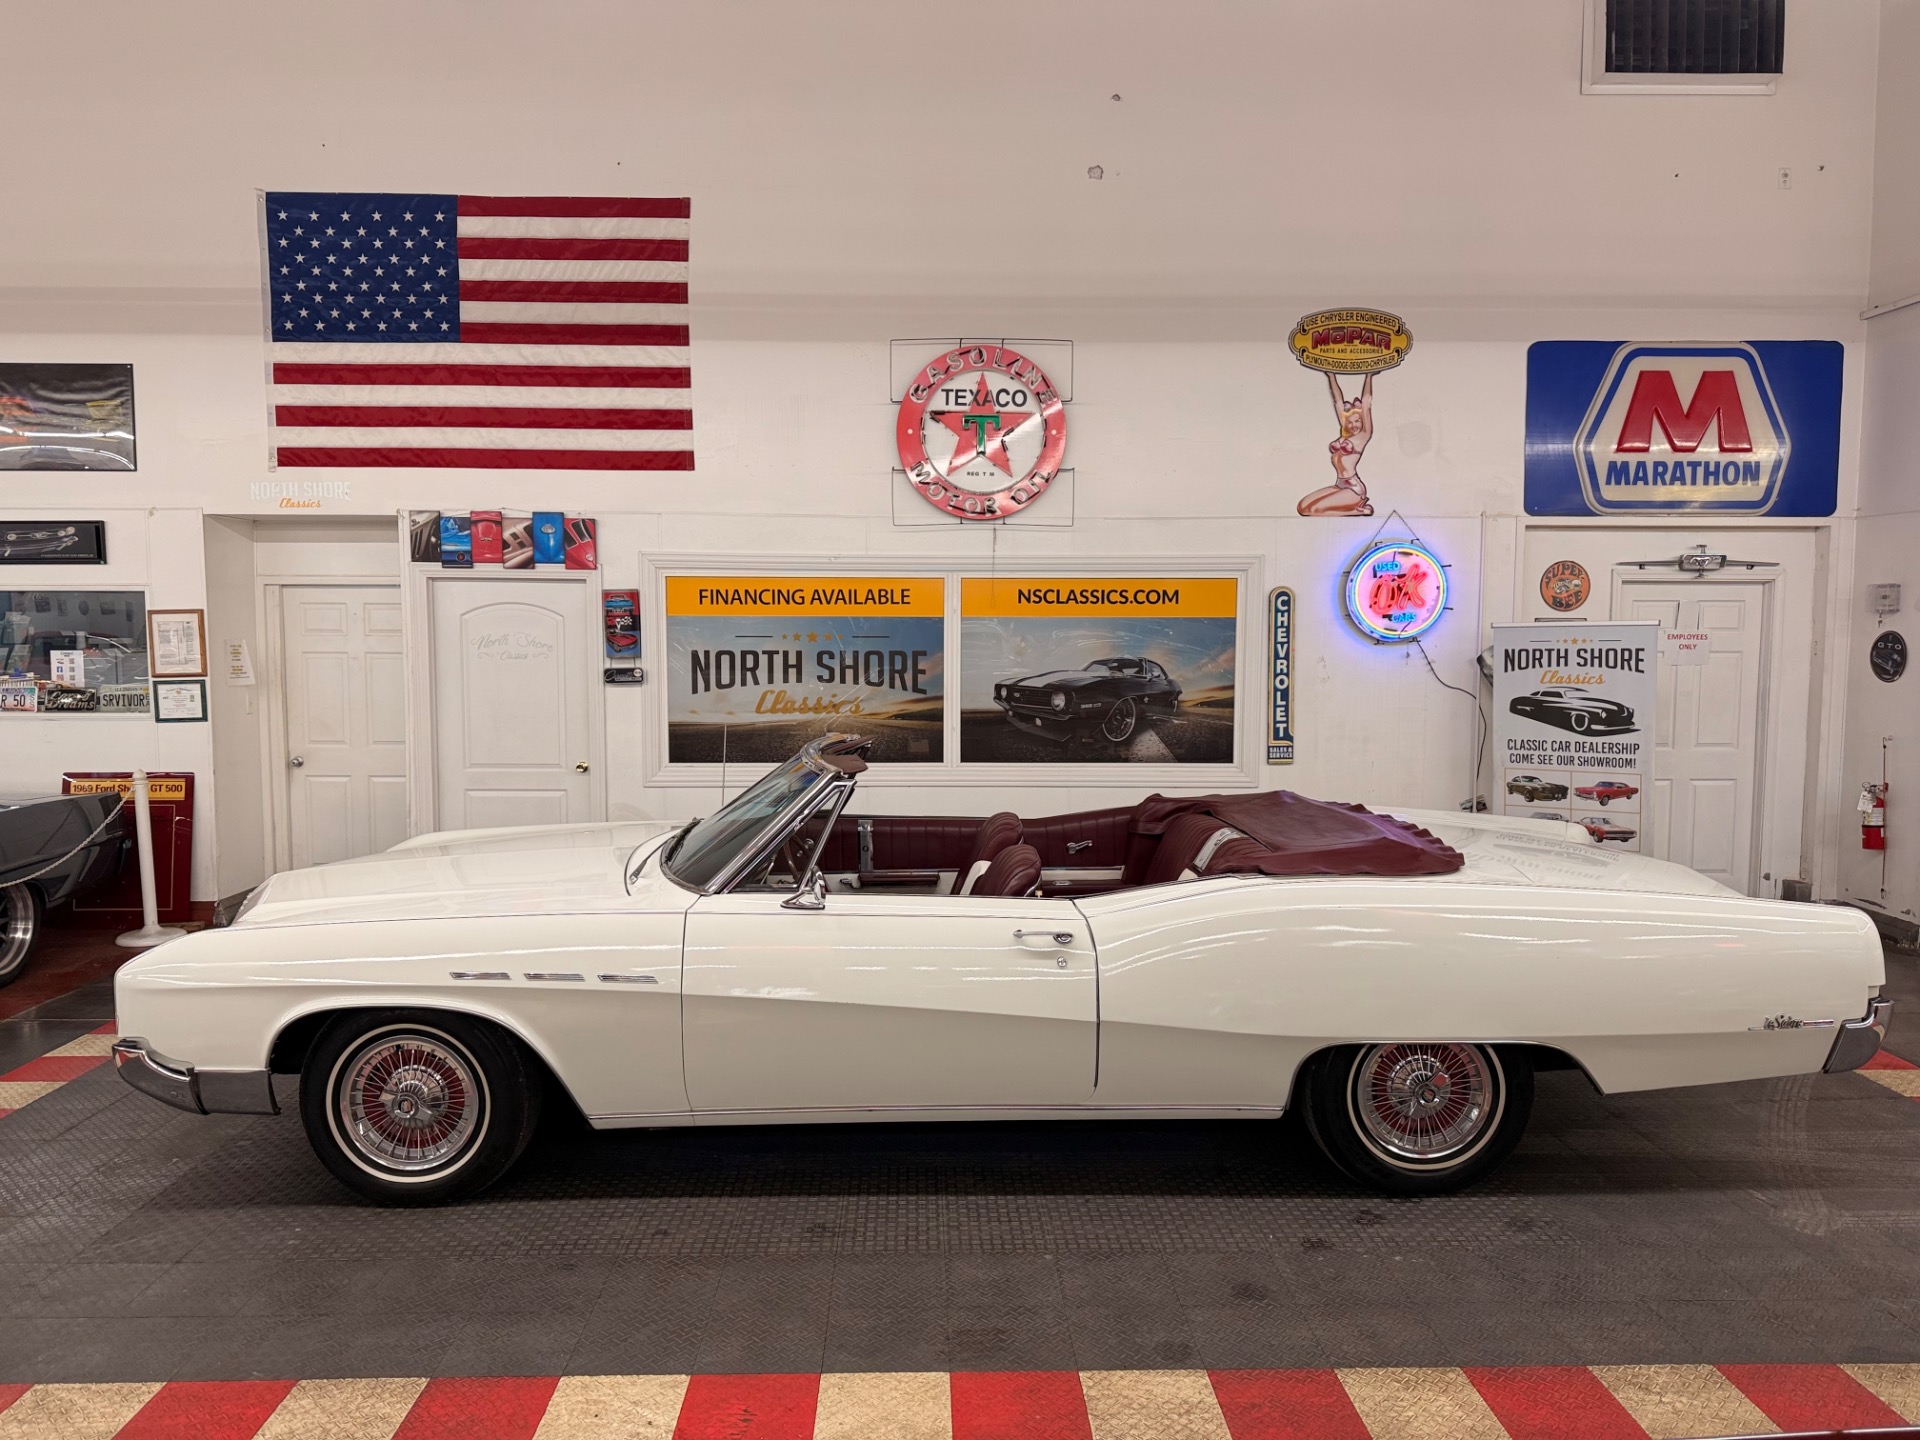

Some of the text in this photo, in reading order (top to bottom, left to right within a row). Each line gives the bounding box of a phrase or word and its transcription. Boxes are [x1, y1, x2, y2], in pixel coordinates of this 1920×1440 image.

[1305, 312, 1396, 327] USE CHRYSLER ENGINEERED
[909, 347, 1057, 404] GASOLINE
[941, 388, 1028, 407] TEXACO
[1614, 370, 1753, 453] M
[962, 414, 1001, 455] T
[1605, 461, 1761, 486] MARATHON
[250, 481, 352, 500] NORTH SHORE
[910, 460, 1054, 517] MOTOR OIL
[279, 498, 321, 508] Classics
[1374, 561, 1401, 571] USED
[699, 588, 911, 606] FINANCING AVAILABLE
[1017, 588, 1180, 605] NSCLASSICS.COM
[1369, 563, 1428, 615] OK
[1551, 590, 1583, 609] BEE
[1391, 613, 1417, 623] CARS
[471, 632, 554, 651] North Shore
[1877, 642, 1902, 650] GTO
[1274, 596, 1289, 738] CHEVROLET
[1504, 648, 1645, 673] NORTH SHORE
[691, 649, 928, 694] NORTH SHORE
[1539, 669, 1606, 685] Classics
[13, 694, 26, 707] 50
[47, 698, 94, 711] Dreams
[102, 693, 145, 707] SRVIVOR
[754, 689, 866, 715] Classics
[1507, 738, 1640, 755] CLASSIC CAR DEALERSHIP
[1509, 752, 1637, 769] COME SEE OUR SHOWROOM!
[95, 784, 115, 793] Ford
[150, 784, 163, 793] GT
[165, 784, 183, 793] 500
